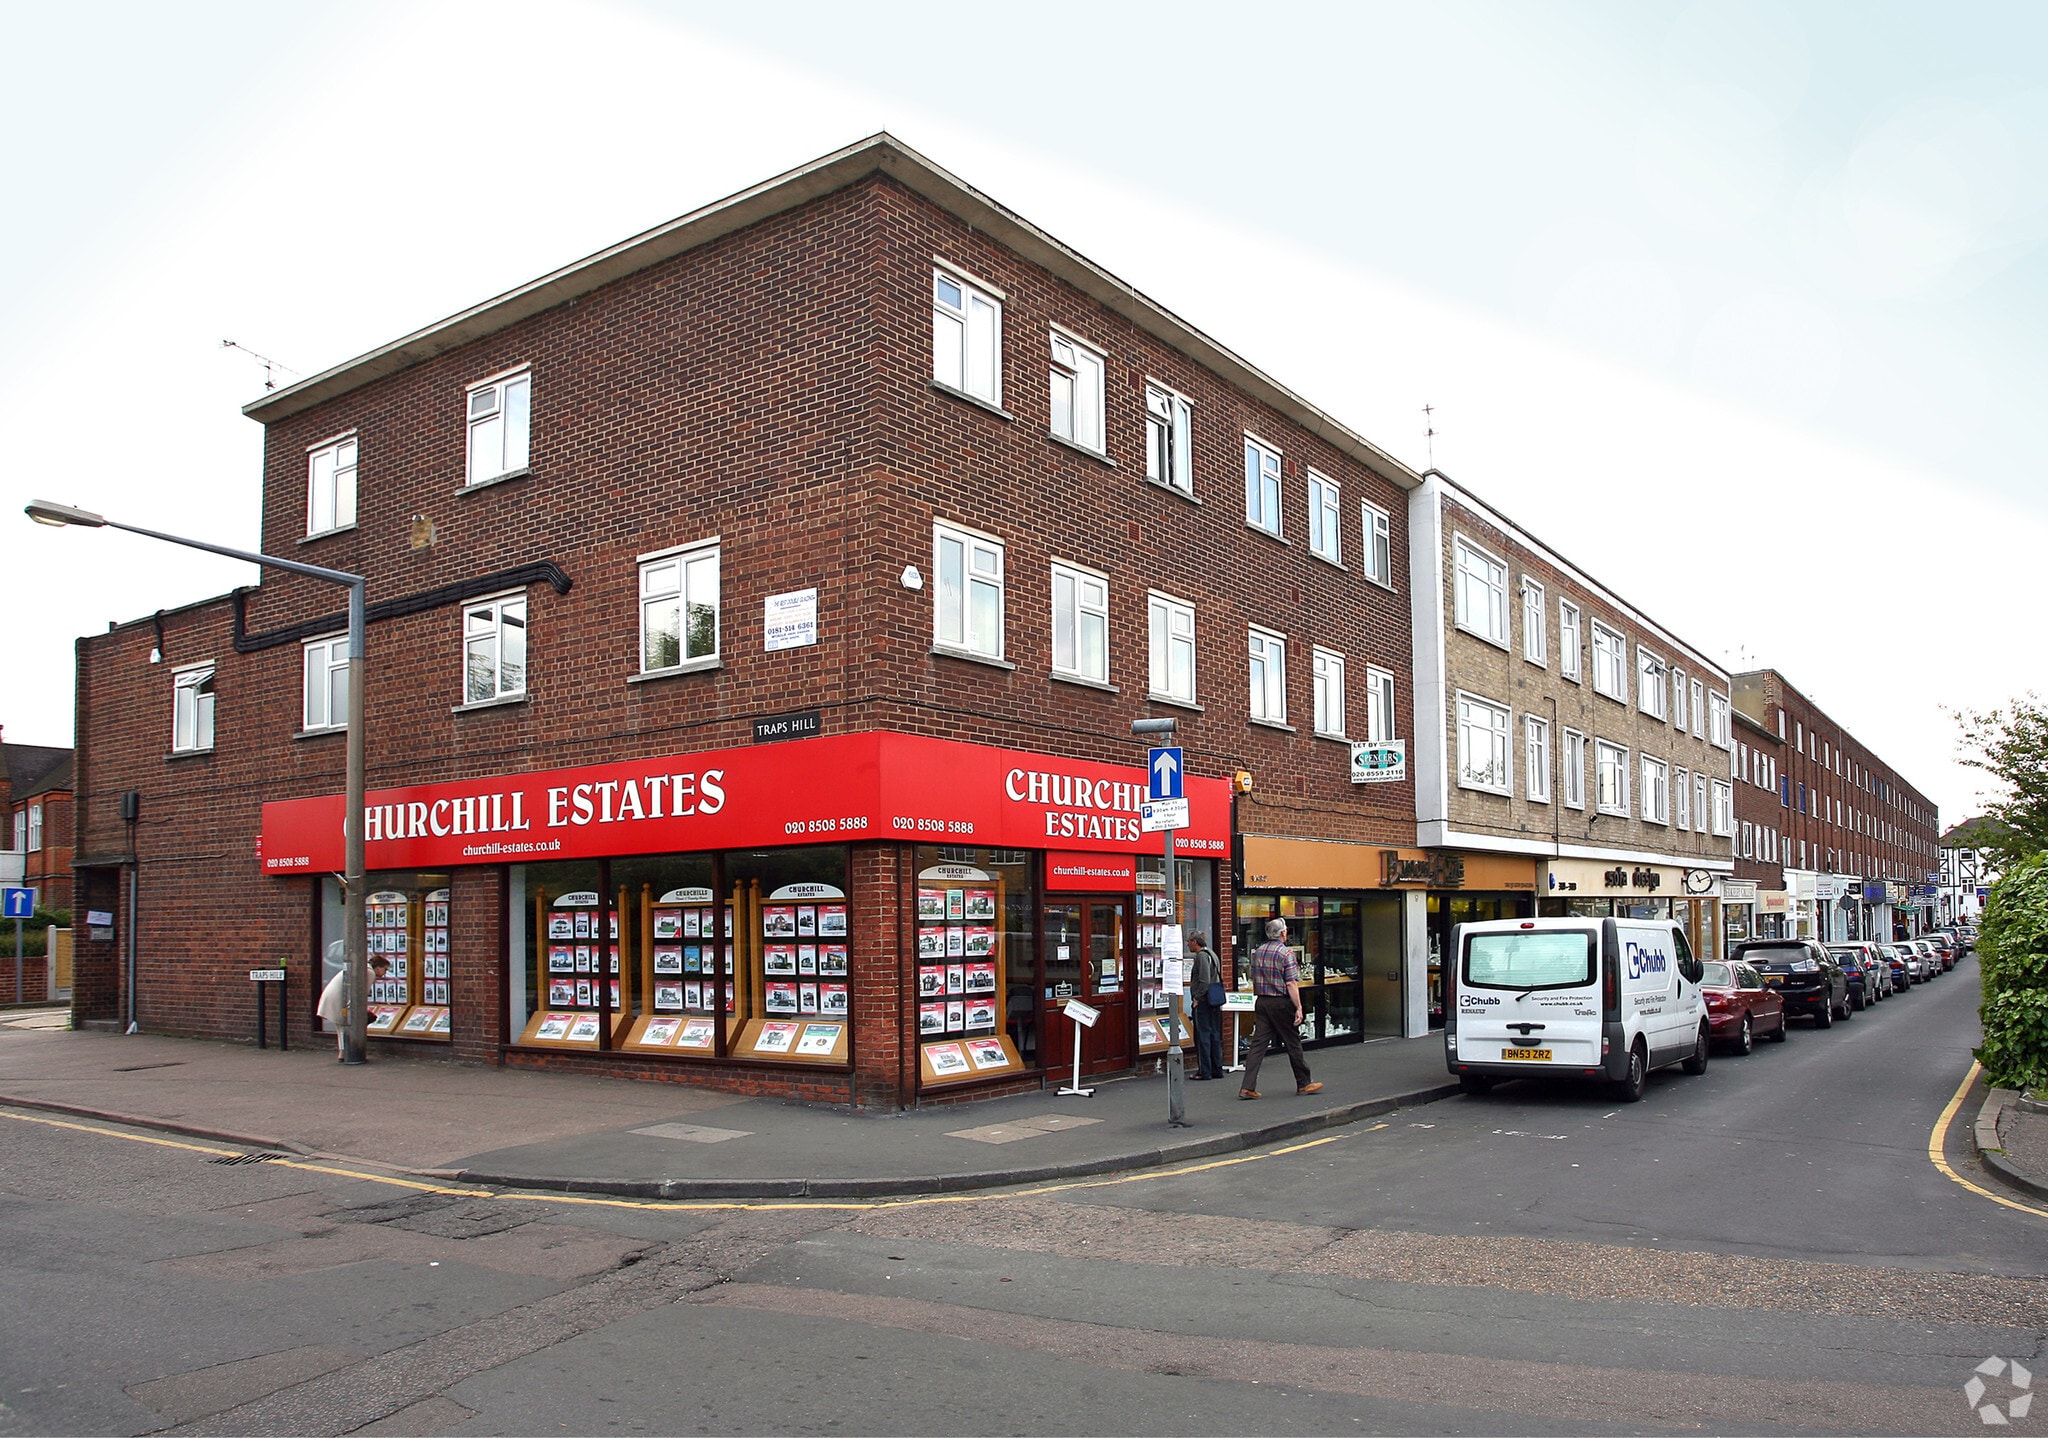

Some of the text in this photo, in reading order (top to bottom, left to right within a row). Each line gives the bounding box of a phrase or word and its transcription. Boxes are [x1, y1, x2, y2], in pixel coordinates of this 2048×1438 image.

[757, 717, 816, 736] TRAPS HILL
[1359, 752, 1399, 766] SPENCERS
[1005, 767, 1149, 814] CHURCHI
[343, 769, 725, 841] HURCHILL ESTATES
[784, 816, 868, 835] 020 8508 5888
[892, 816, 974, 834] 020 8508 5888
[1045, 811, 1140, 841] ESTATES
[462, 838, 561, 857] churchill-estates.co.uk
[1175, 837, 1224, 851] 020 8508 5888
[937, 867, 972, 875] CHURCHILL
[1053, 865, 1130, 878] churchill-estates.co.uk
[1632, 866, 1661, 893] design
[788, 885, 824, 893] CHURCHILL
[1166, 900, 1172, 908] S
[1639, 947, 1666, 973] Chubb
[1471, 996, 1501, 1005] Chubb
[1507, 1049, 1551, 1059] BN53 ZRZ
